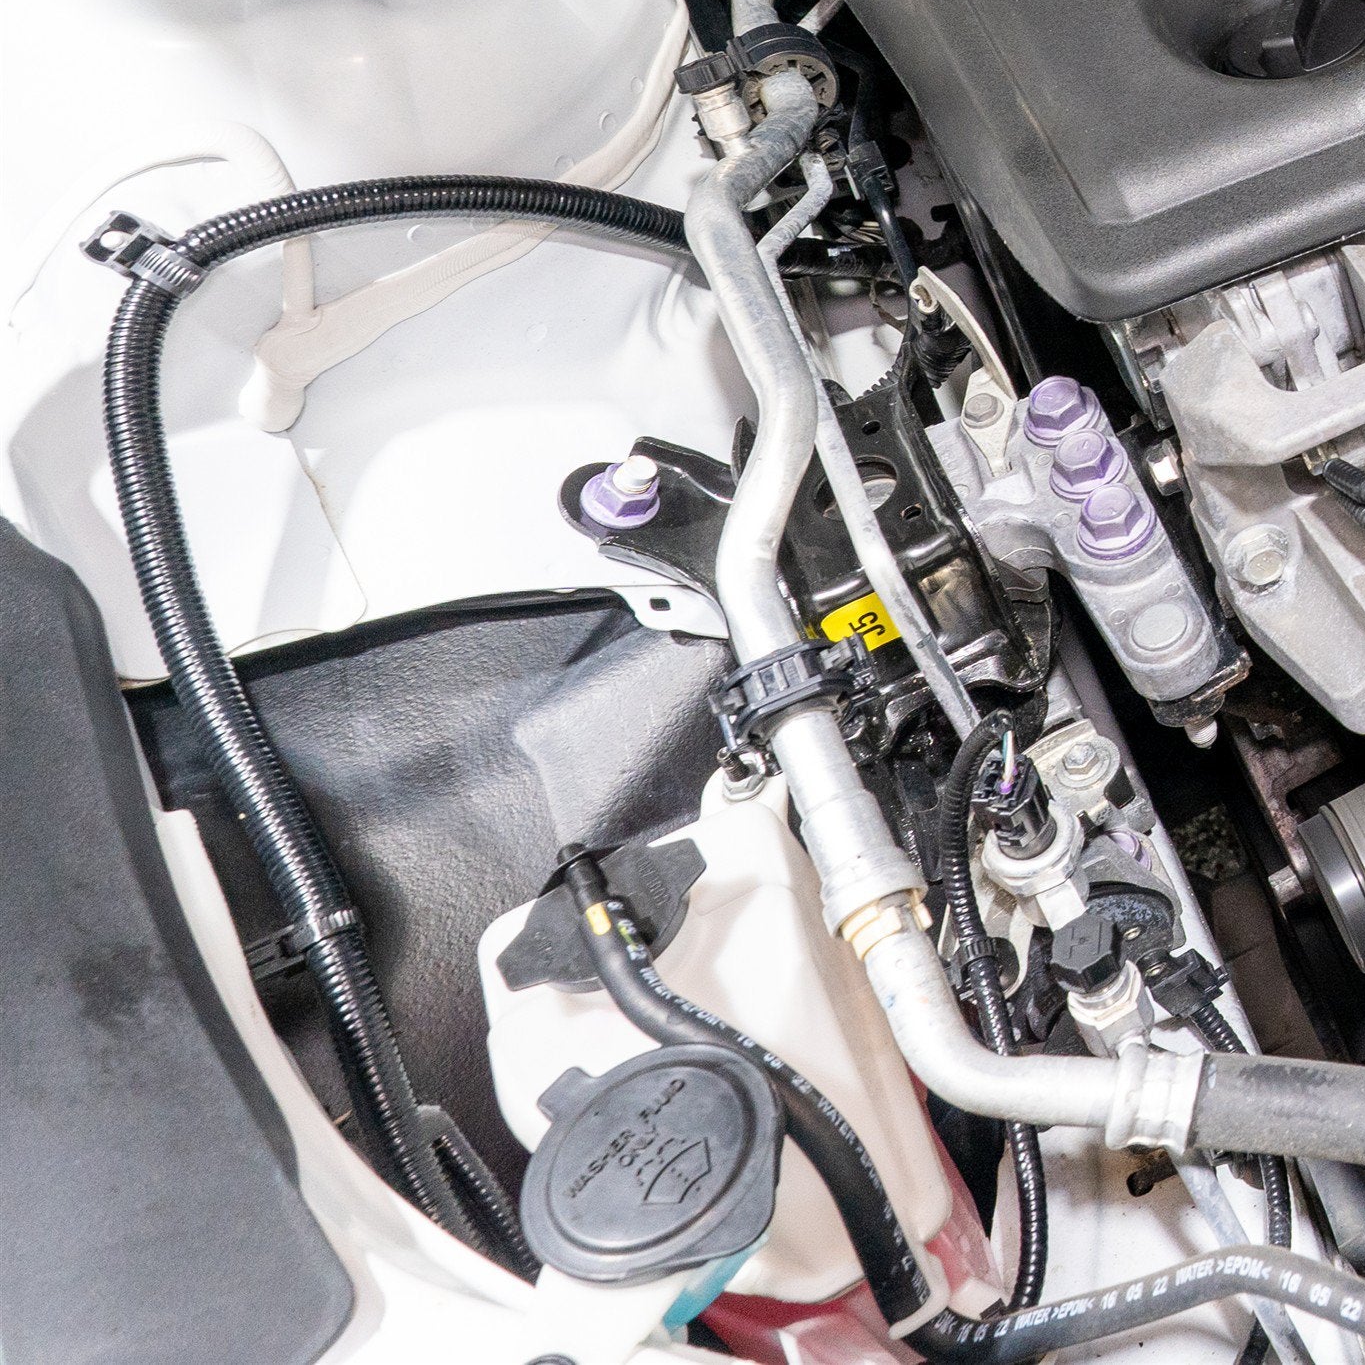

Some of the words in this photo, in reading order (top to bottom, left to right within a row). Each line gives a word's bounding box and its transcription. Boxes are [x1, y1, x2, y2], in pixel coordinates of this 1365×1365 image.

[563, 1128, 636, 1199] WASHER
[637, 1077, 687, 1121] FLUID
[618, 1124, 660, 1168] ONLY
[1013, 1305, 1051, 1332] WATER
[1174, 1257, 1214, 1287] WATER
[1339, 1296, 1364, 1323] 22
